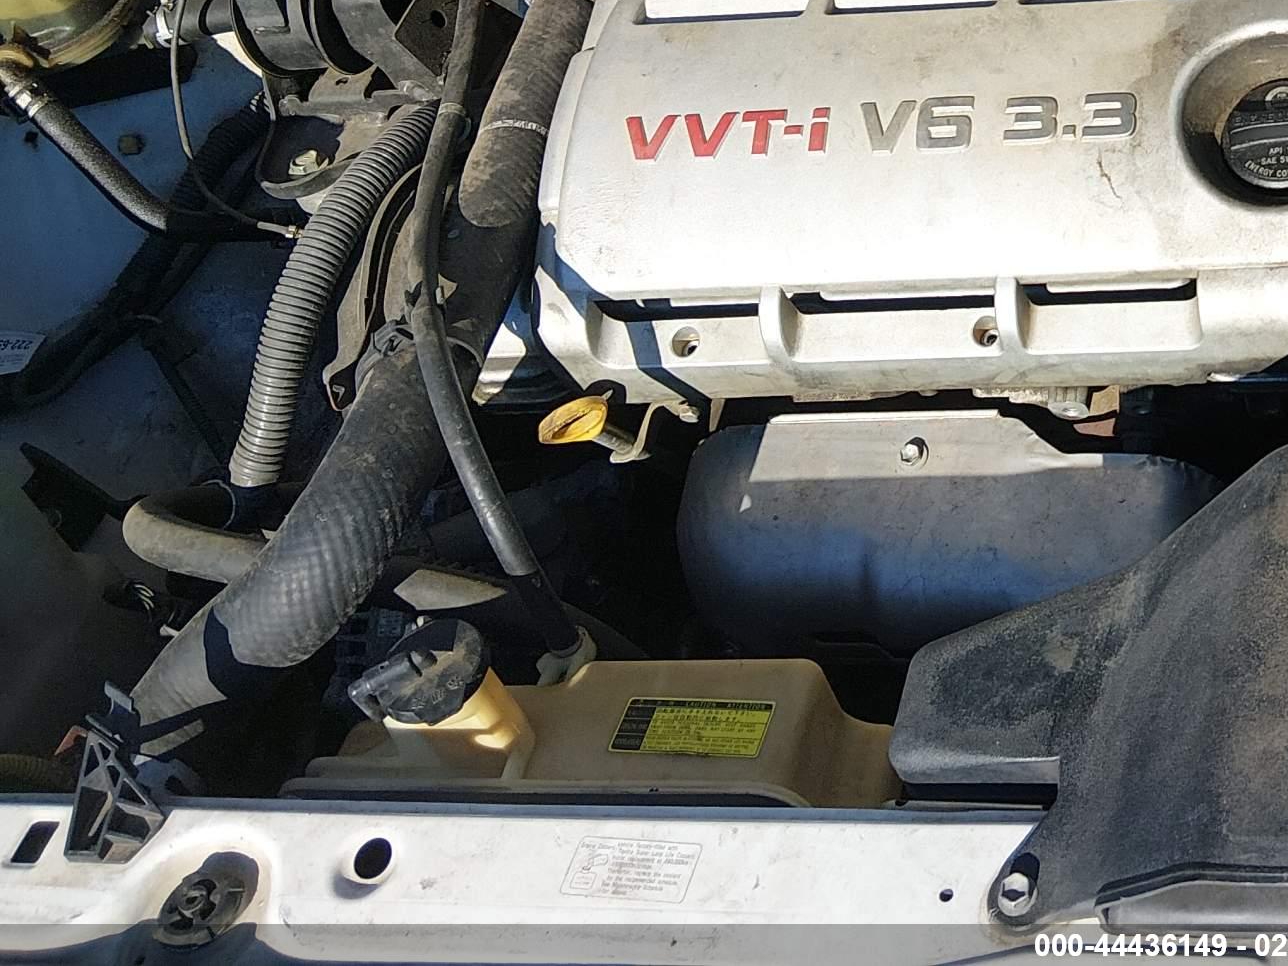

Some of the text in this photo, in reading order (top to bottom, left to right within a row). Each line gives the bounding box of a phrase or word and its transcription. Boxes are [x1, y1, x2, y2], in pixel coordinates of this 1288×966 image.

[626, 92, 1138, 161] VVT-i V6 3.3
[1269, 146, 1283, 156] API
[1261, 157, 1277, 166] SAE
[1244, 160, 1274, 178] ENERGY
